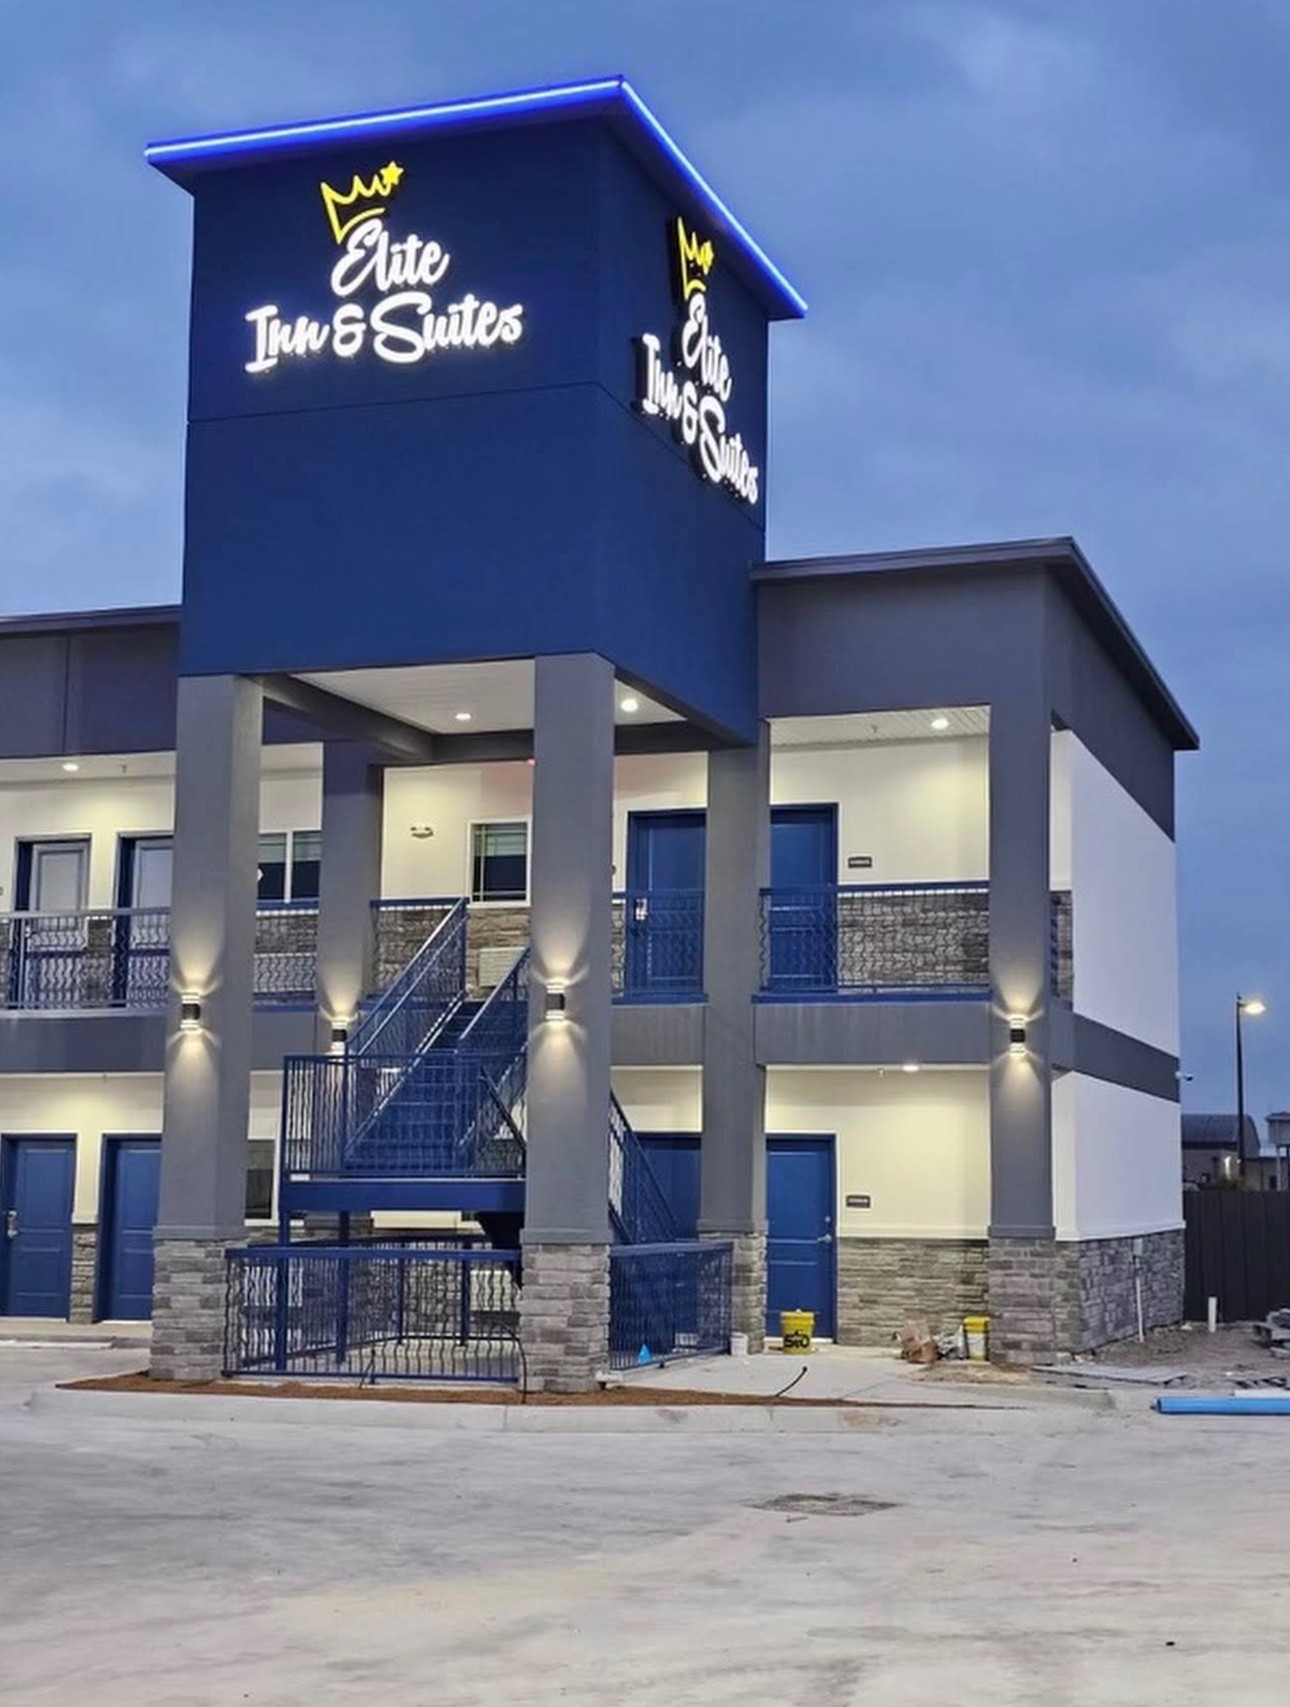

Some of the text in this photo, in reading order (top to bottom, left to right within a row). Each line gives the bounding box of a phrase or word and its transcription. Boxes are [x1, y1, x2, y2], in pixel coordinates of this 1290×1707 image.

[331, 218, 450, 297] Elite
[245, 291, 524, 373] Inn & Suites
[682, 294, 732, 402] Elite
[642, 333, 682, 419] Inn
[699, 395, 758, 504] Suites
